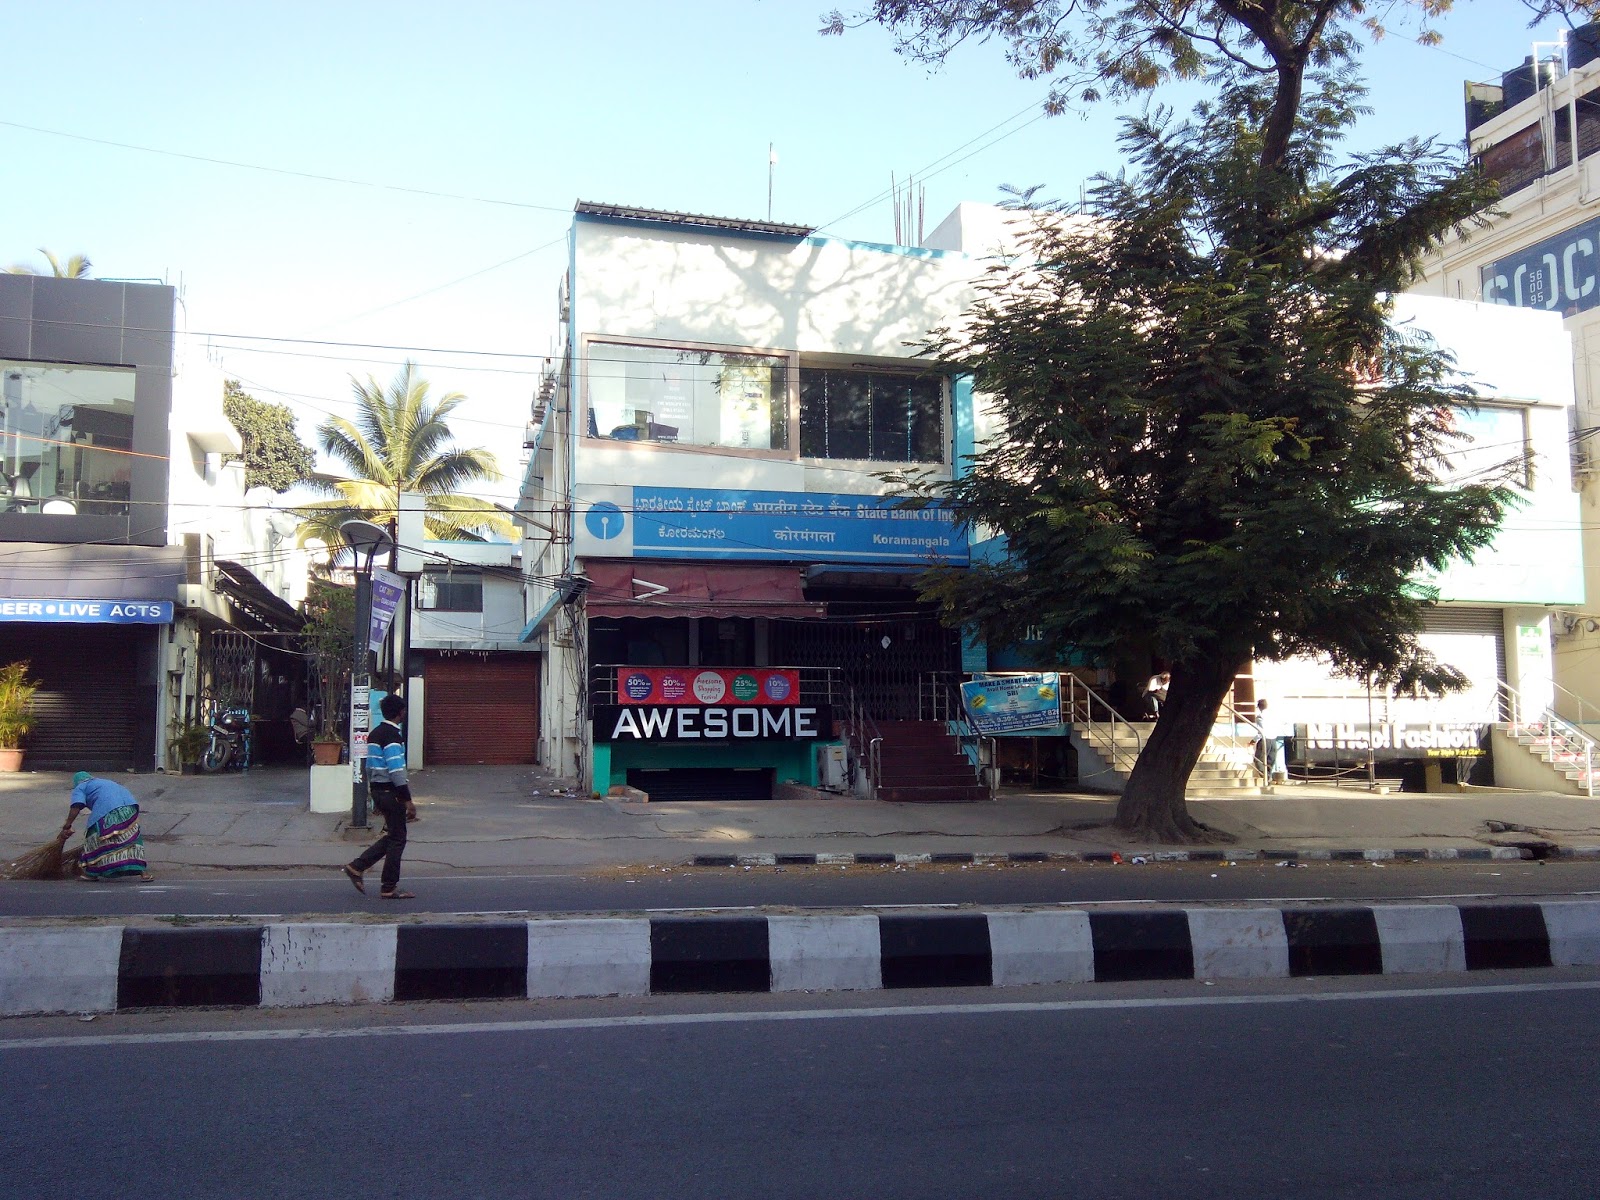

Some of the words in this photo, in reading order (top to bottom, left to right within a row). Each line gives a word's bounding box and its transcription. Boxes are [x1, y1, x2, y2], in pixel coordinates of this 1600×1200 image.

[1529, 269, 1543, 283] 56
[1530, 291, 1544, 305] 95
[752, 499, 798, 515] भारतीय
[856, 503, 888, 520] State
[890, 505, 919, 520] Bank
[922, 508, 935, 521] of
[773, 526, 836, 543] कोरमंगला
[873, 533, 950, 548] Koramangala
[0, 602, 42, 616] EER
[58, 603, 100, 616] LIVE
[110, 604, 161, 617] ACTS
[628, 678, 646, 686] 50%
[663, 679, 680, 687] 30%
[696, 676, 722, 685] Awesome
[697, 685, 721, 694] Shopping
[611, 707, 818, 739] AWESOME
[1306, 722, 1333, 749] Ni
[1393, 722, 1479, 749] Fashion
